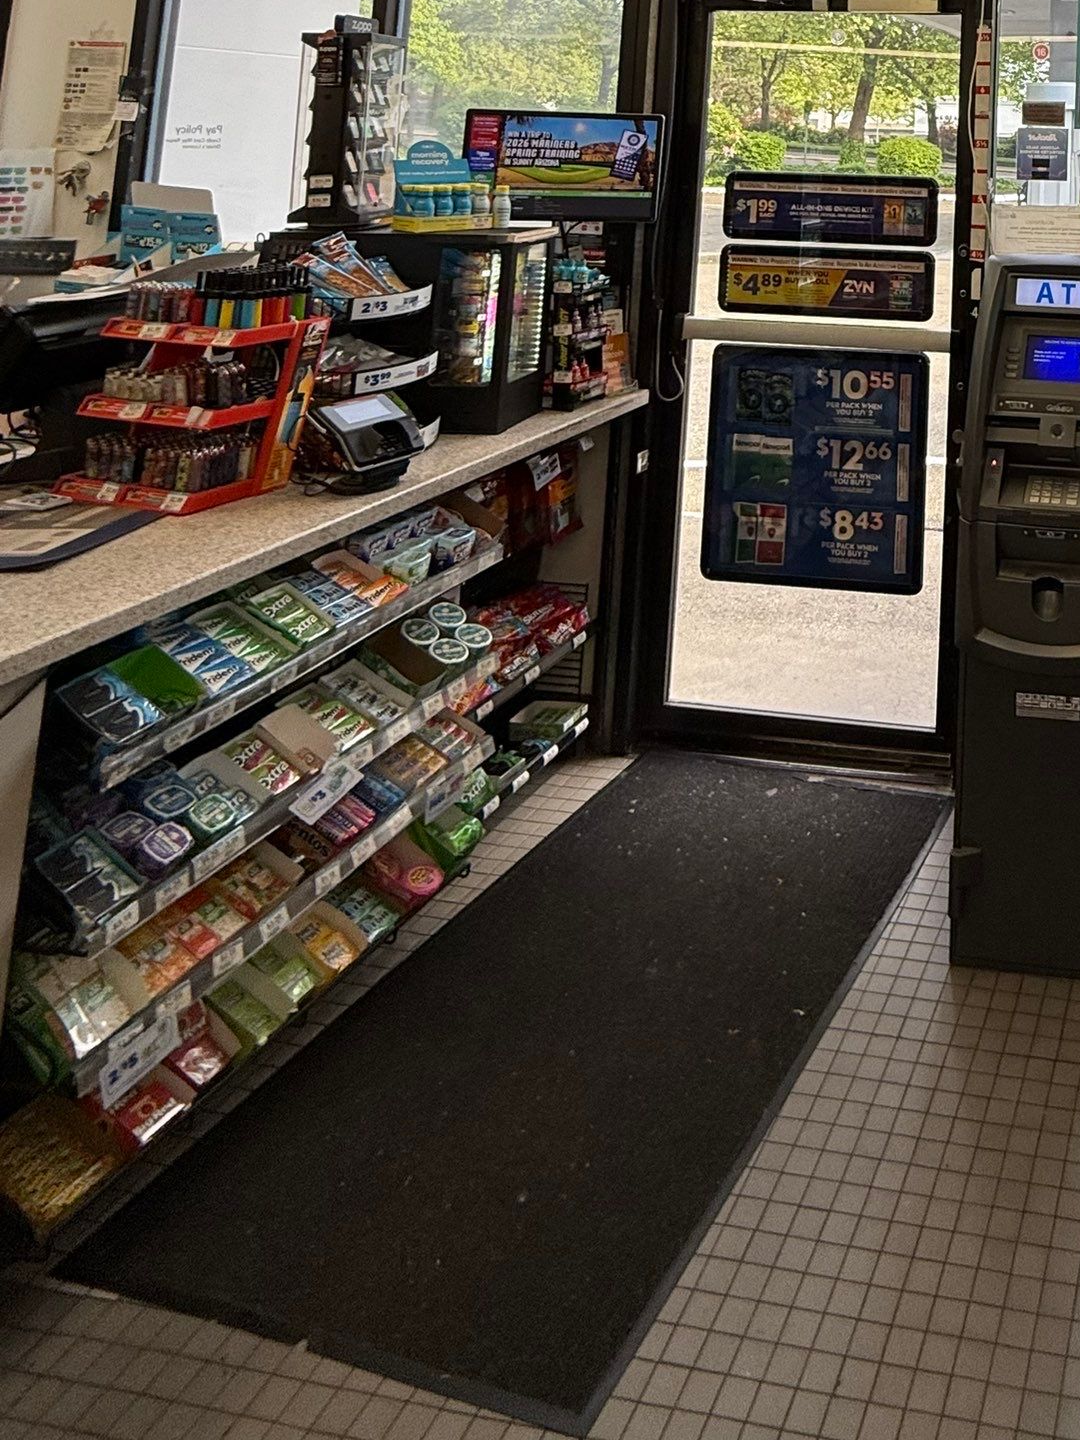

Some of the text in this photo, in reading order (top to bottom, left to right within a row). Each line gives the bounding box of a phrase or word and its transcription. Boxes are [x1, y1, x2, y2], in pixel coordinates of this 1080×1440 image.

[1036, 48, 1047, 57] 16
[506, 140, 576, 149] 2026 MARINERS
[411, 151, 448, 160] morning
[505, 148, 580, 159] SPRING TRAINING
[843, 279, 875, 295] ZYN
[970, 307, 978, 318] 4
[840, 402, 860, 410] PACK
[861, 402, 883, 411] WHEN
[851, 409, 867, 417] BUY
[839, 471, 858, 480] PACK
[859, 472, 881, 481] WHEN
[849, 478, 865, 486] BUY
[836, 541, 856, 551] PACK
[856, 543, 878, 552] WHEN
[846, 549, 862, 558] BUY
[364, 581, 395, 602] Trident
[223, 631, 254, 650] Trident
[179, 646, 214, 666] Trident
[251, 647, 279, 666] Trident
[202, 664, 239, 685] Trident
